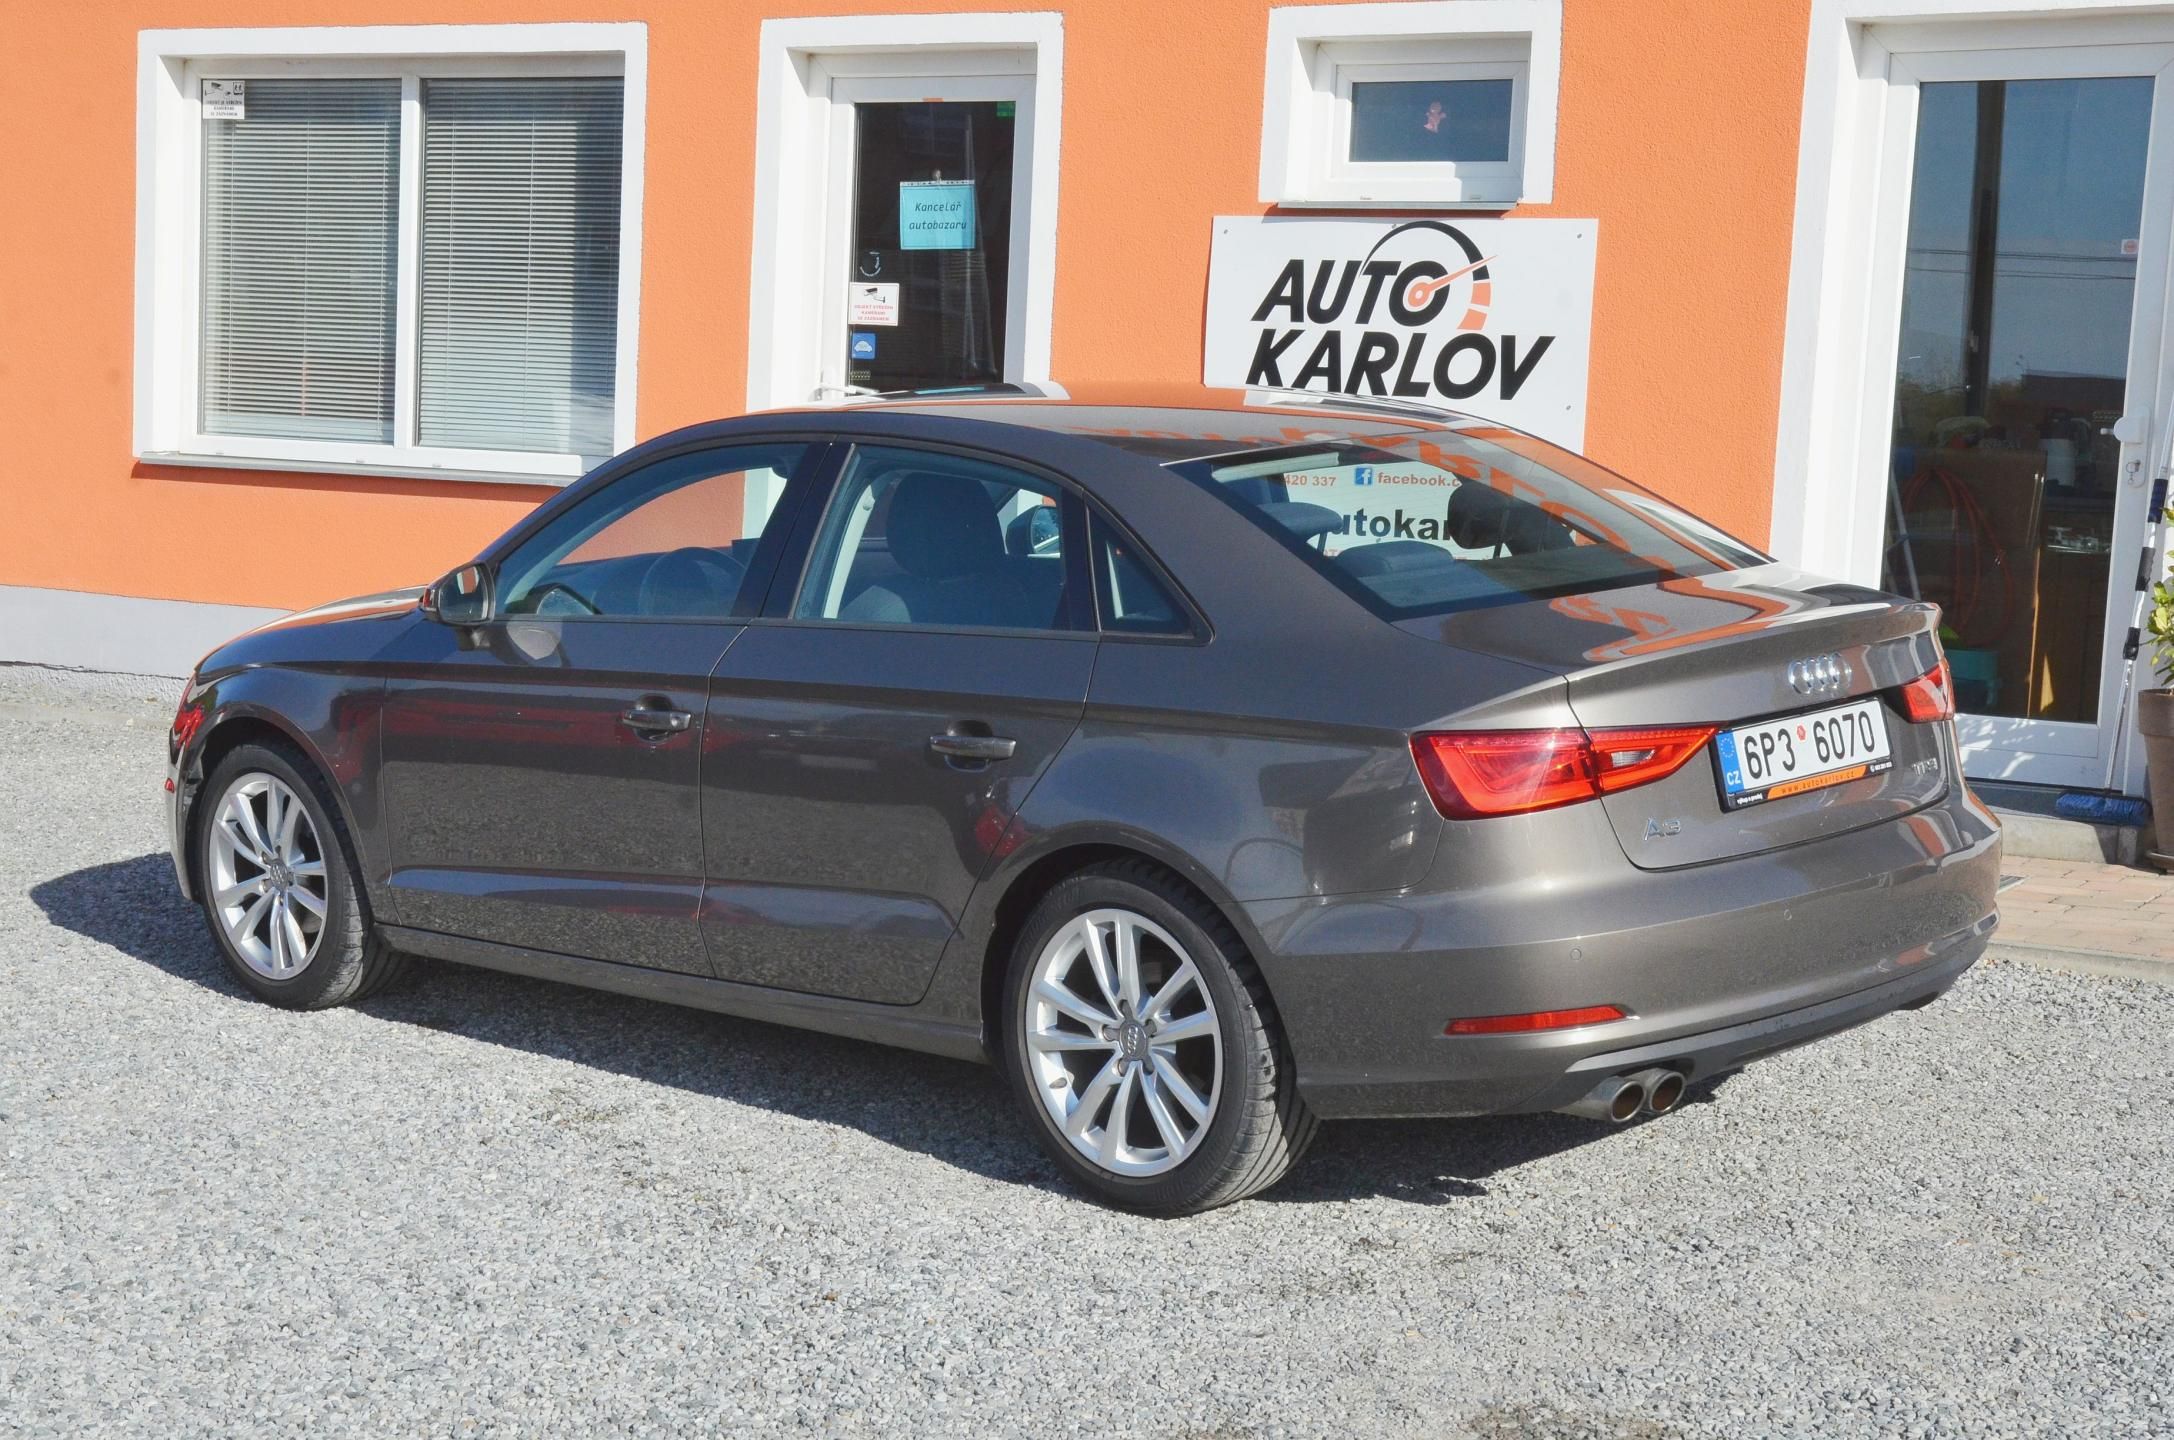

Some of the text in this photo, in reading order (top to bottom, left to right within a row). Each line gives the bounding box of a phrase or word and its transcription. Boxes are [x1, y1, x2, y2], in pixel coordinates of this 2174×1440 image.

[908, 220, 967, 230] autobazaru
[1250, 258, 1451, 327] AUTO
[1245, 328, 1557, 401] KARLOV
[1312, 475, 1337, 487] 337
[1743, 710, 1875, 780] 6P3 6070
[1726, 770, 1741, 786] CZ
[1643, 817, 1682, 841] A3
